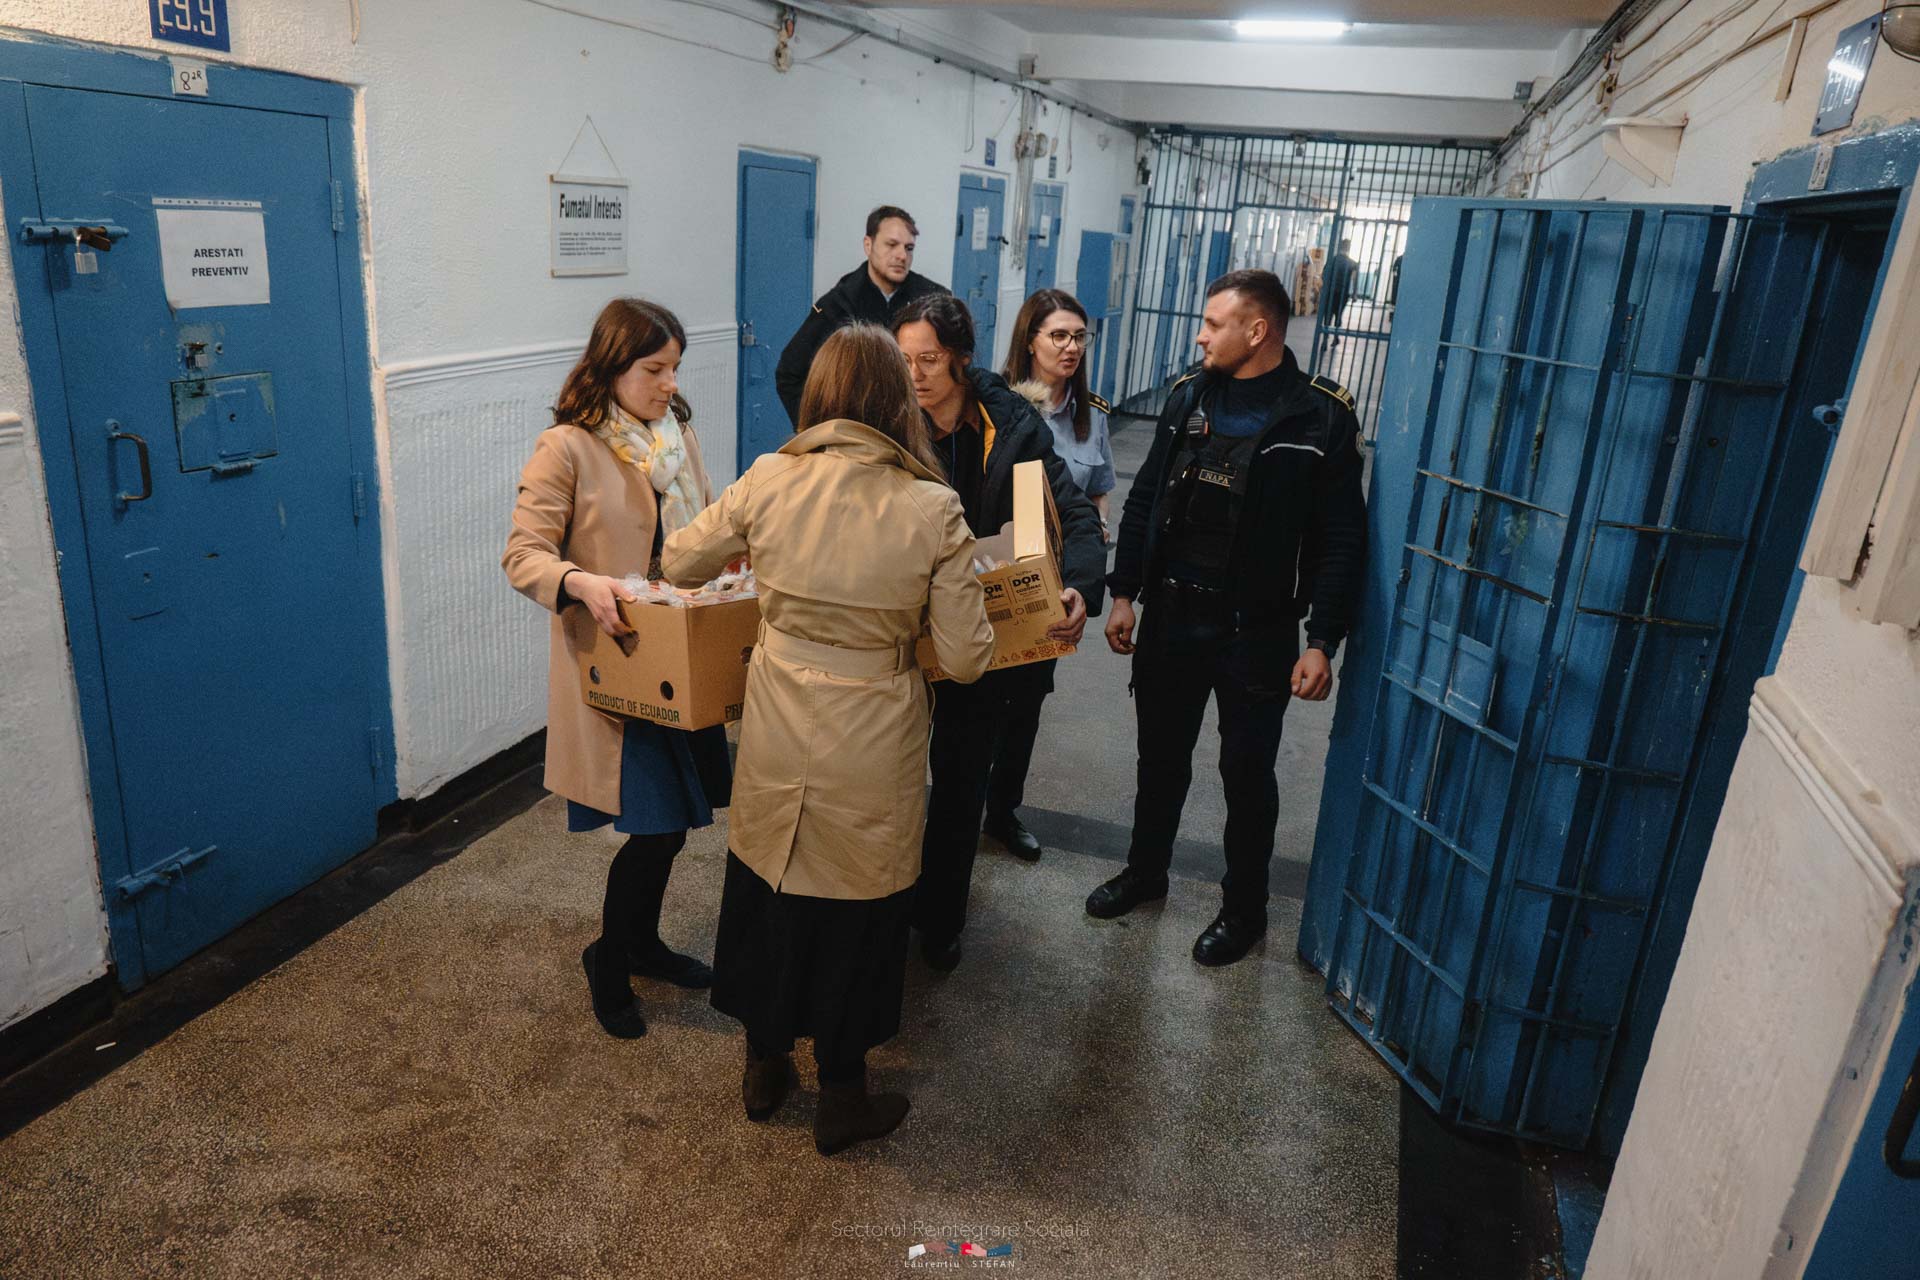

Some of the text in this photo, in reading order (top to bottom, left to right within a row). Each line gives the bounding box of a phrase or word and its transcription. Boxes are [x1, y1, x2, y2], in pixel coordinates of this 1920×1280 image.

[560, 193, 622, 219] Fumatul Interzis
[193, 248, 243, 258] ARESTATI
[191, 267, 249, 277] PREVENTIV
[1012, 573, 1040, 587] DOR
[984, 584, 1003, 594] OR
[588, 690, 680, 723] PRODUCT OF ECUADOR
